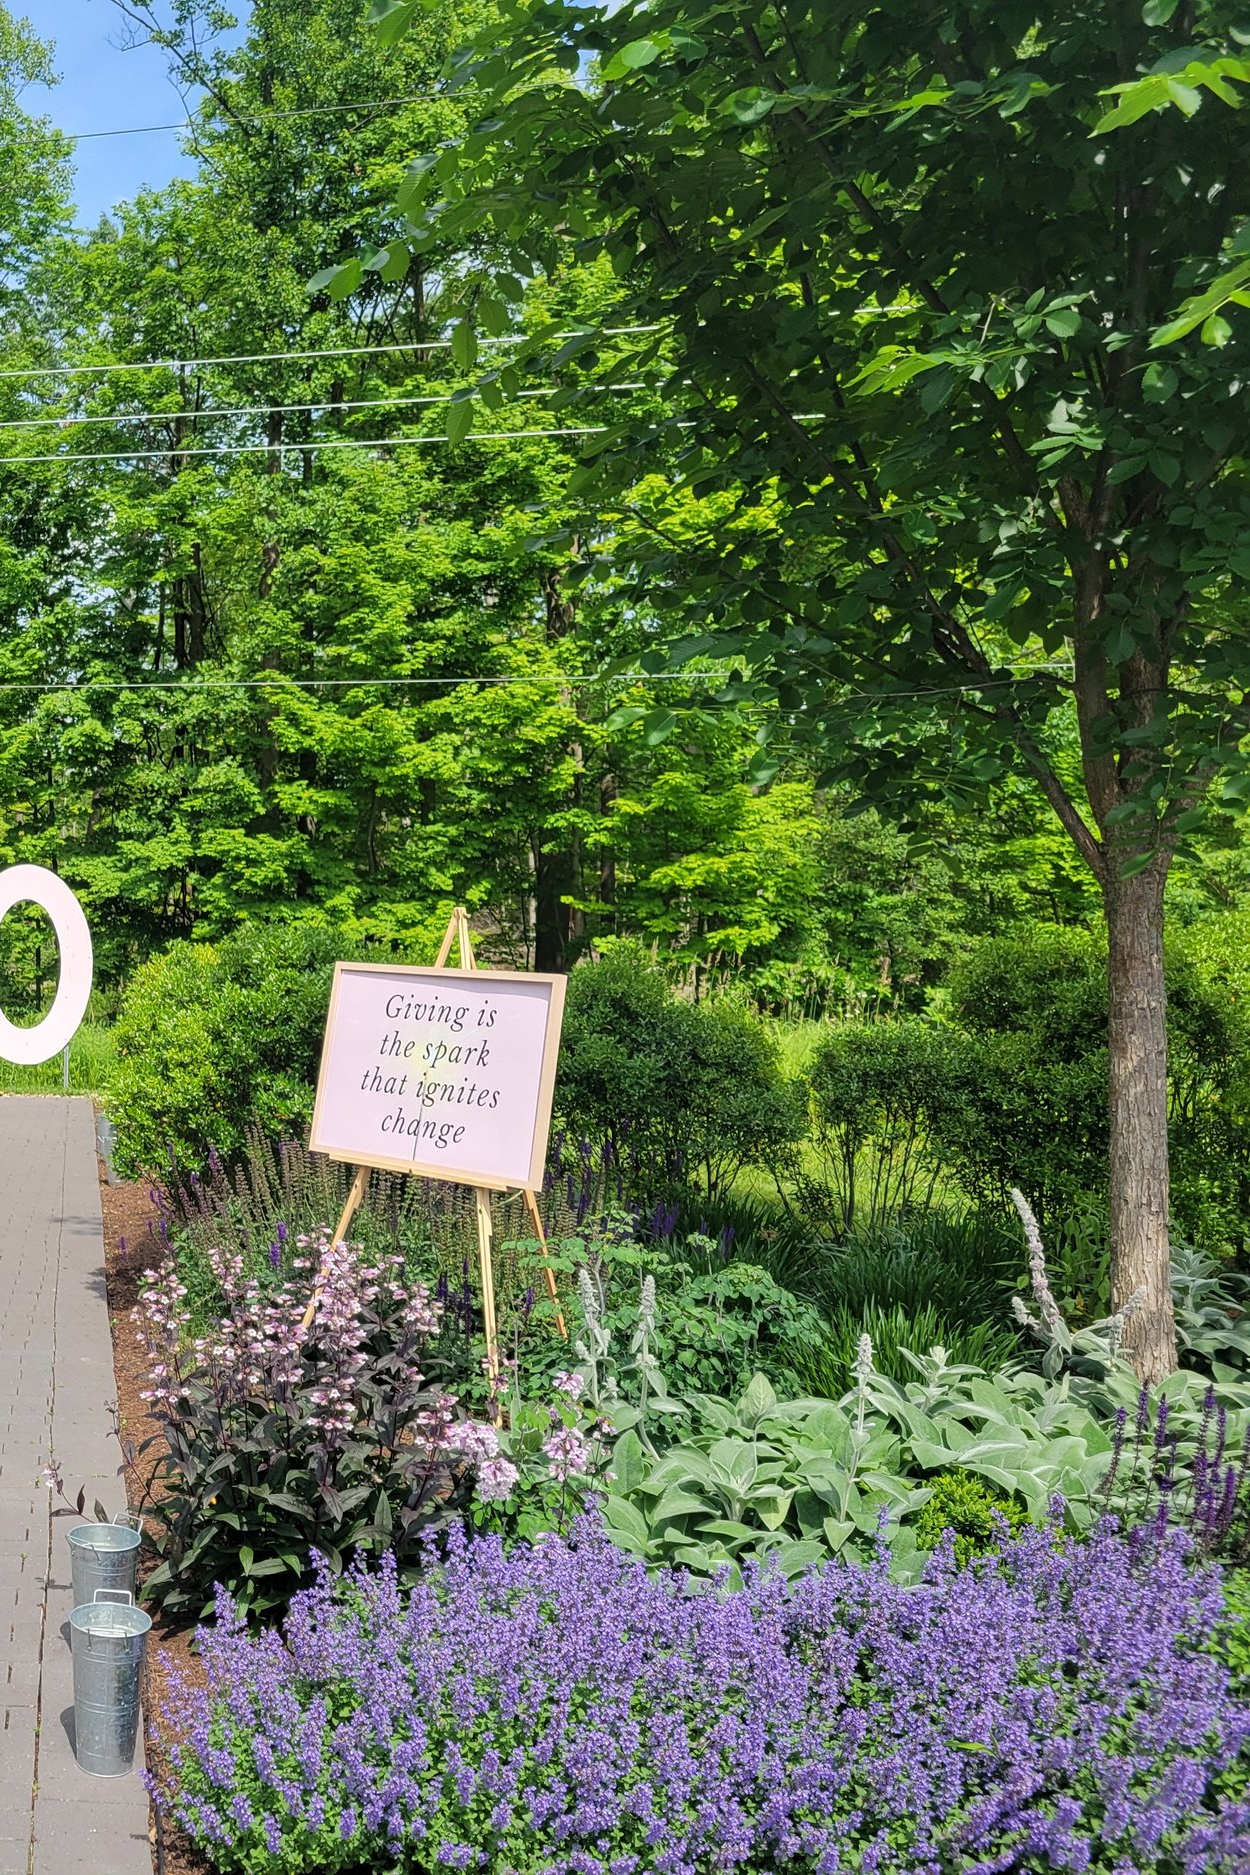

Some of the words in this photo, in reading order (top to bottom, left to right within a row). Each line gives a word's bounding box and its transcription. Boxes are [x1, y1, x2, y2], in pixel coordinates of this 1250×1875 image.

[385, 994, 470, 1033] Giving
[477, 999, 498, 1028] is
[379, 1030, 415, 1058] the
[422, 1039, 491, 1069] spark
[360, 1066, 408, 1096] that
[416, 1071, 501, 1109] ignites
[380, 1107, 466, 1149] change
